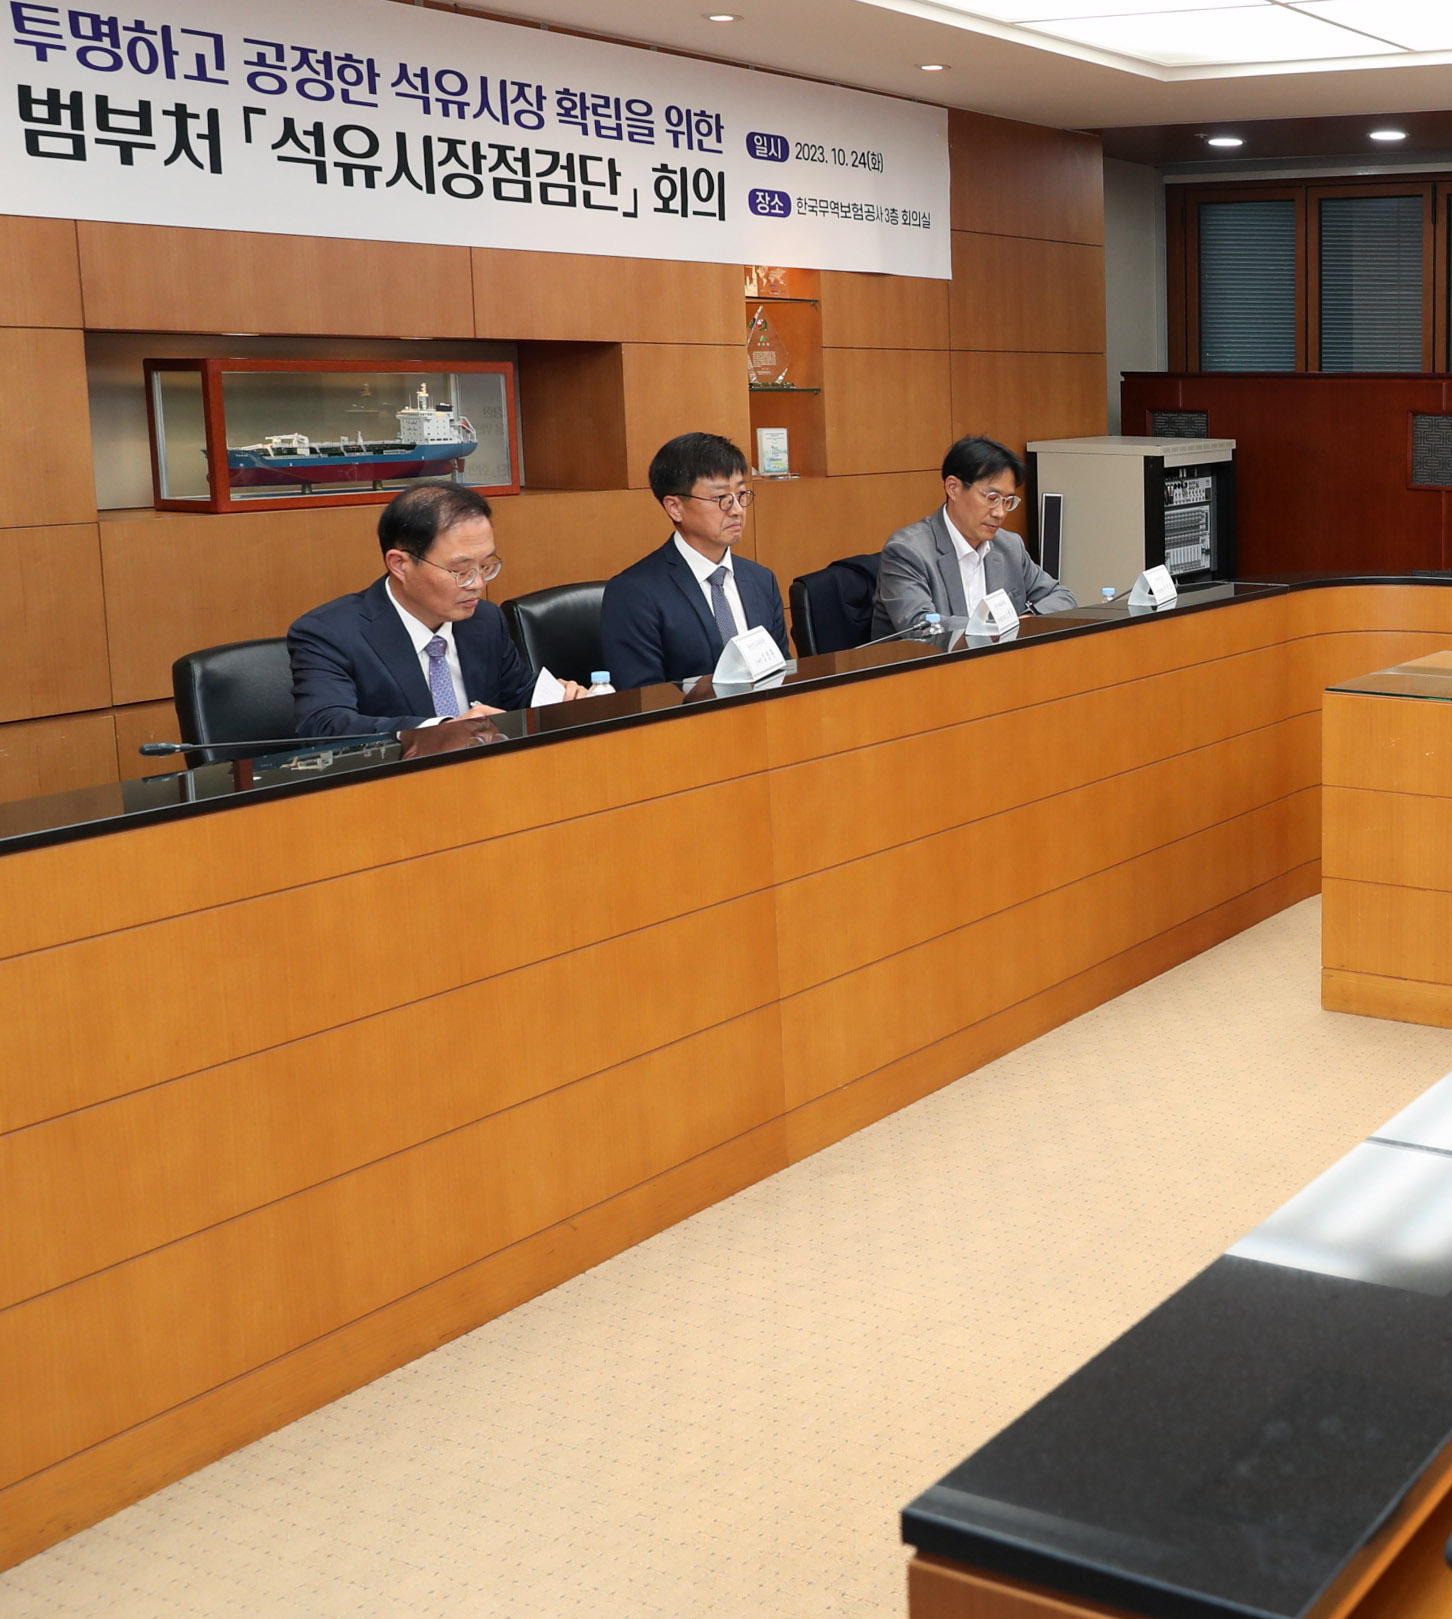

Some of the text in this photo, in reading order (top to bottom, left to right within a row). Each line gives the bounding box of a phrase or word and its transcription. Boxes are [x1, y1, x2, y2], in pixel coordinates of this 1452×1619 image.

[10, 1, 724, 154] 투명하고 공정한 석유시장 확립을 위한
[17, 84, 726, 221] 범부처 「석유시장점검단」 회의
[753, 134, 782, 159] 일시
[795, 142, 884, 173] 2023. 10. 24(화)
[755, 191, 785, 215] 장소
[901, 209, 931, 230] 회의실
